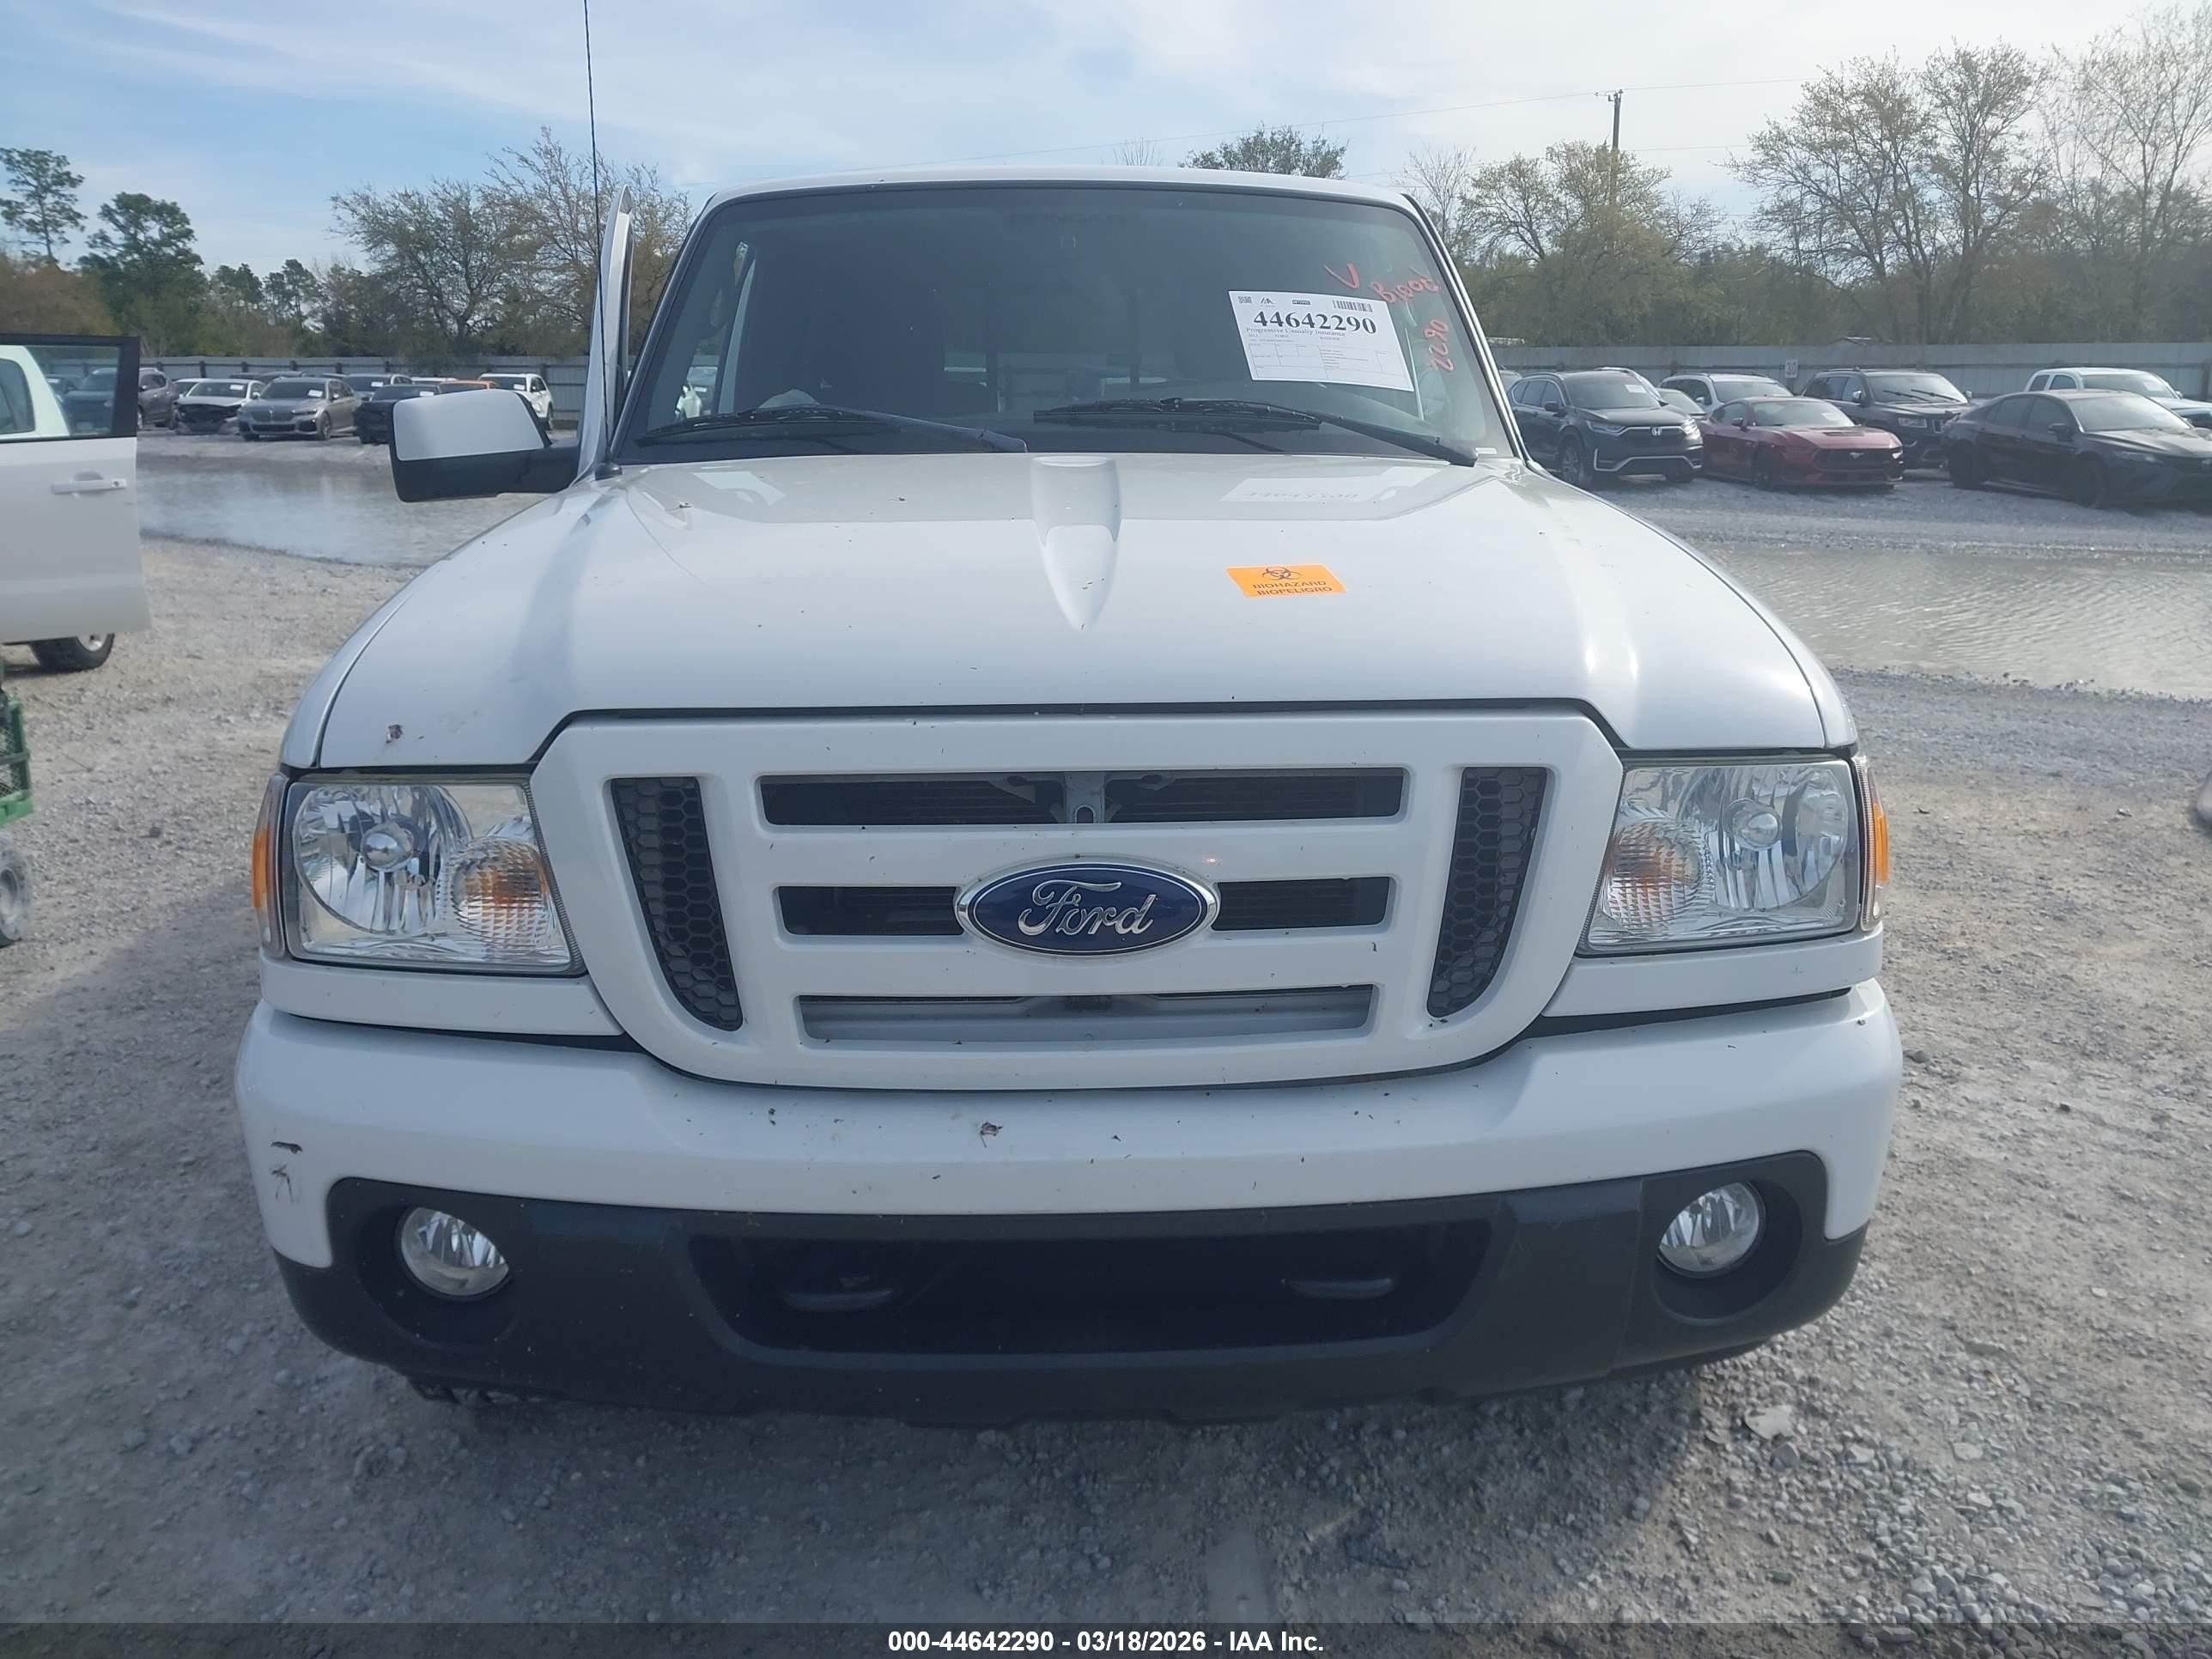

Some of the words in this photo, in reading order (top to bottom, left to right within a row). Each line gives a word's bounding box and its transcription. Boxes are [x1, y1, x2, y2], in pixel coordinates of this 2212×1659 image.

[1254, 310, 1377, 334] 44642290
[1285, 327, 1314, 336] Casualty
[1252, 580, 1327, 590] BIOHAZARD
[1256, 586, 1333, 596] BIOPELIGRO
[1018, 879, 1158, 936] Ford
